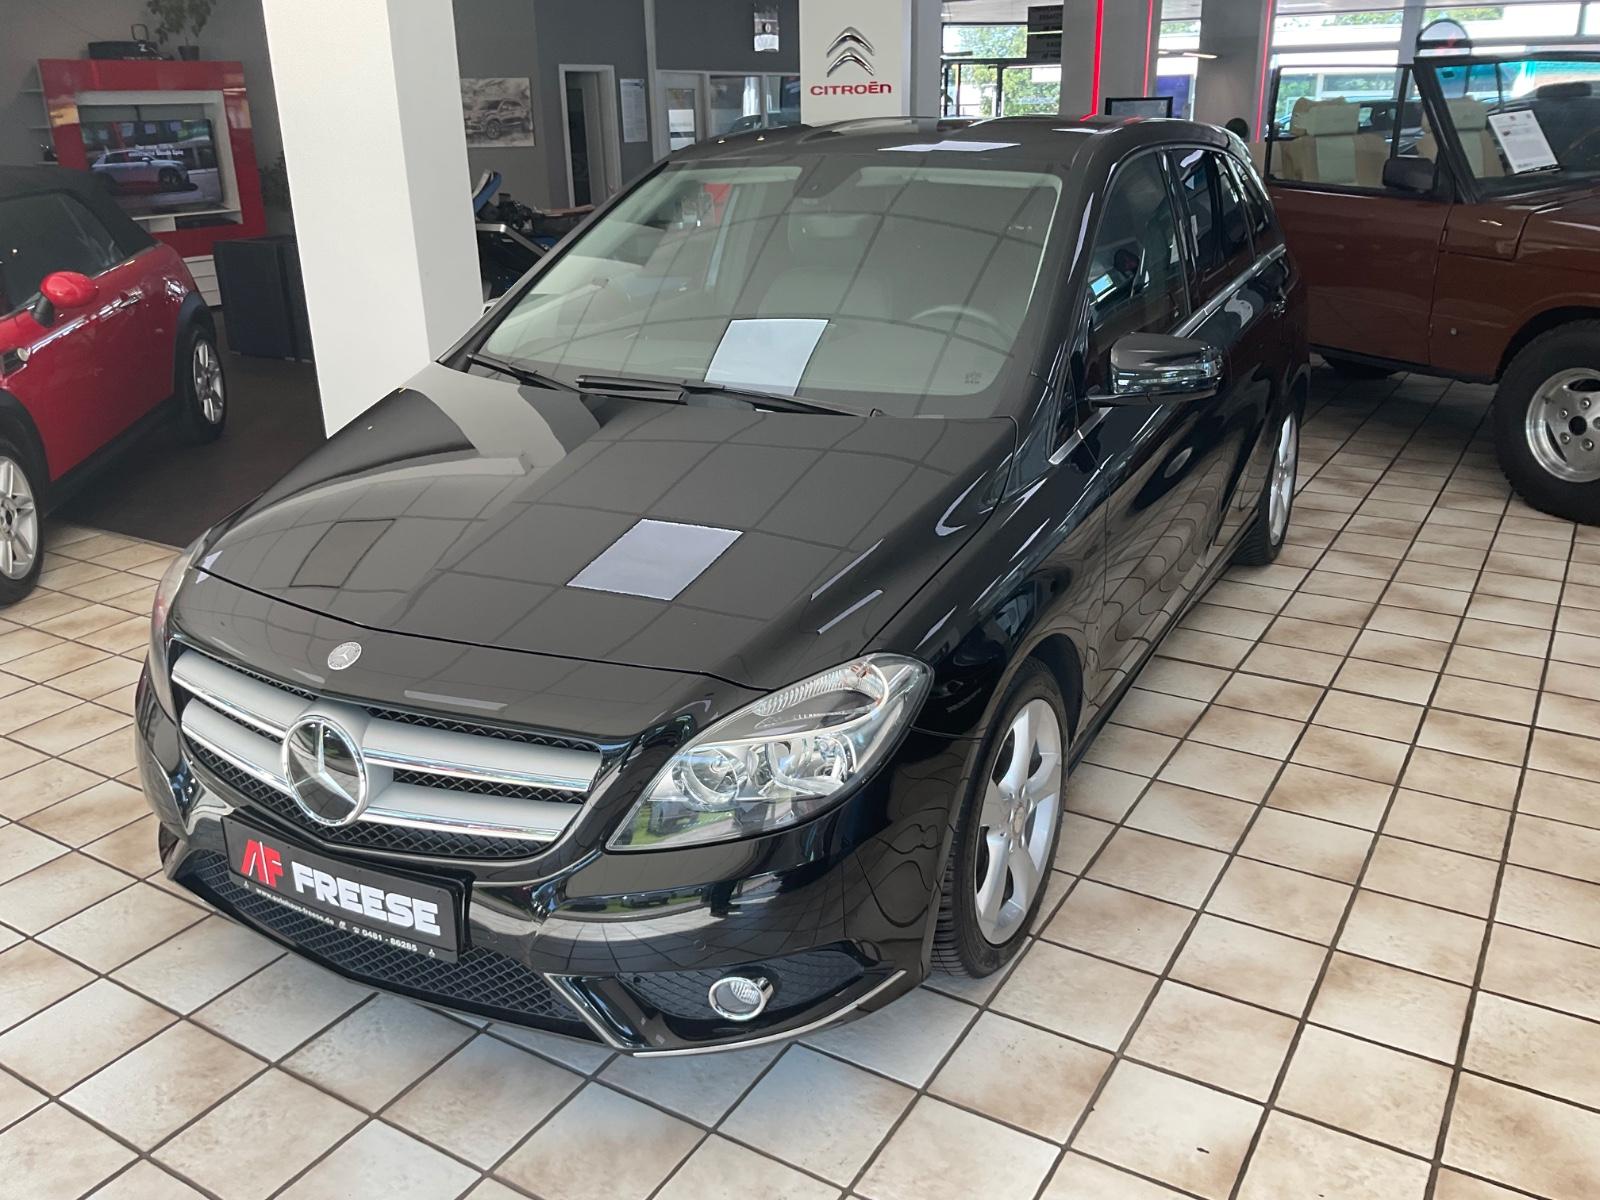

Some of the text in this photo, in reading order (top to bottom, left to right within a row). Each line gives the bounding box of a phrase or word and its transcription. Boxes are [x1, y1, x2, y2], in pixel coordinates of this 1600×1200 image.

[291, 861, 441, 936] FREESE
[361, 929, 382, 941] 0481
[390, 937, 418, 952] 86285
